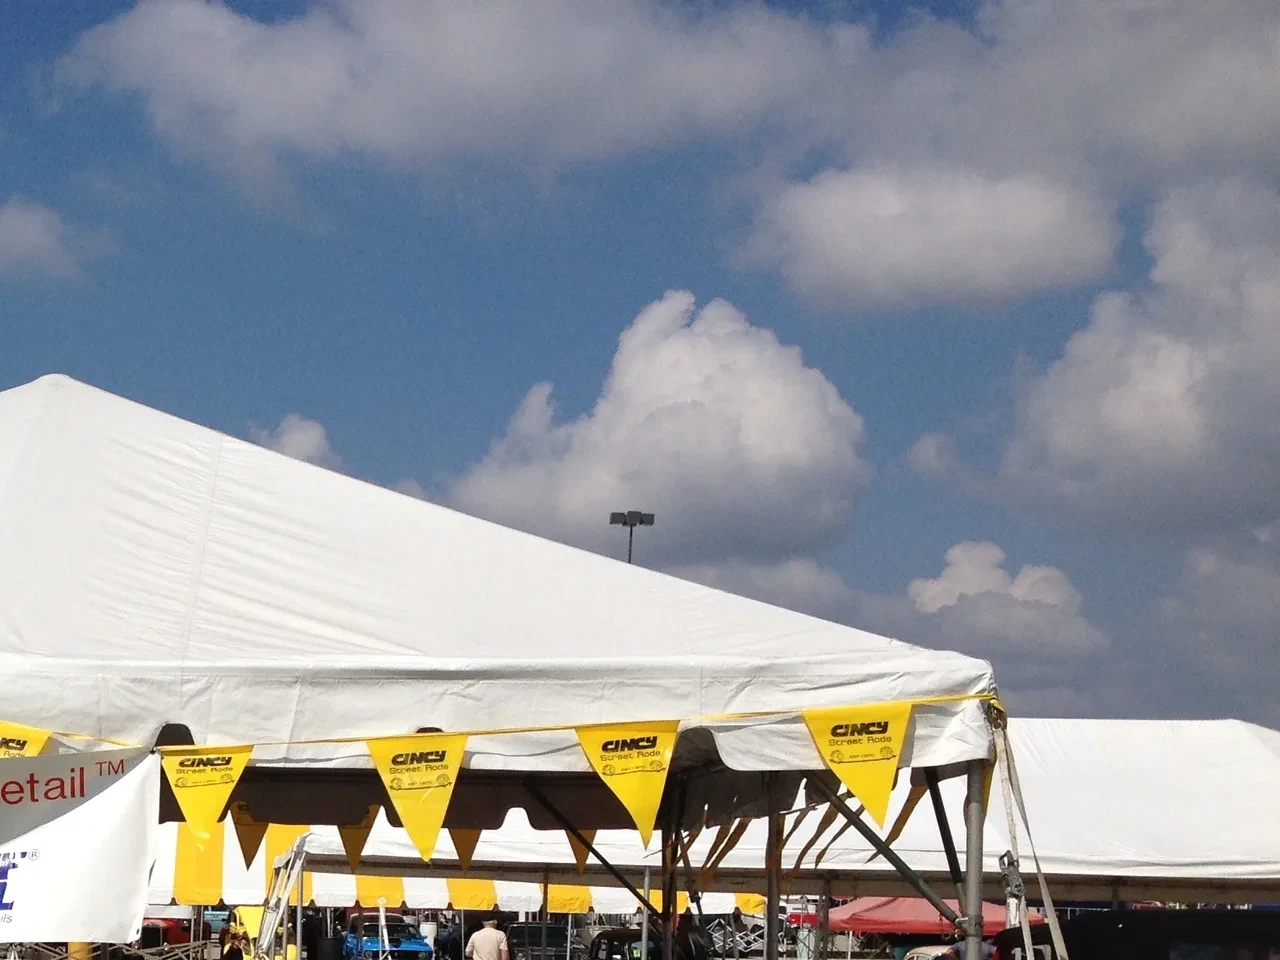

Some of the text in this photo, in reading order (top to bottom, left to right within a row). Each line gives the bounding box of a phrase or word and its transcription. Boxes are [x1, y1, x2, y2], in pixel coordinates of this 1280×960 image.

[830, 721, 889, 737] CINCY
[601, 736, 658, 753] CINCY
[179, 756, 232, 767] CINCY
[391, 750, 447, 766] CINCY
